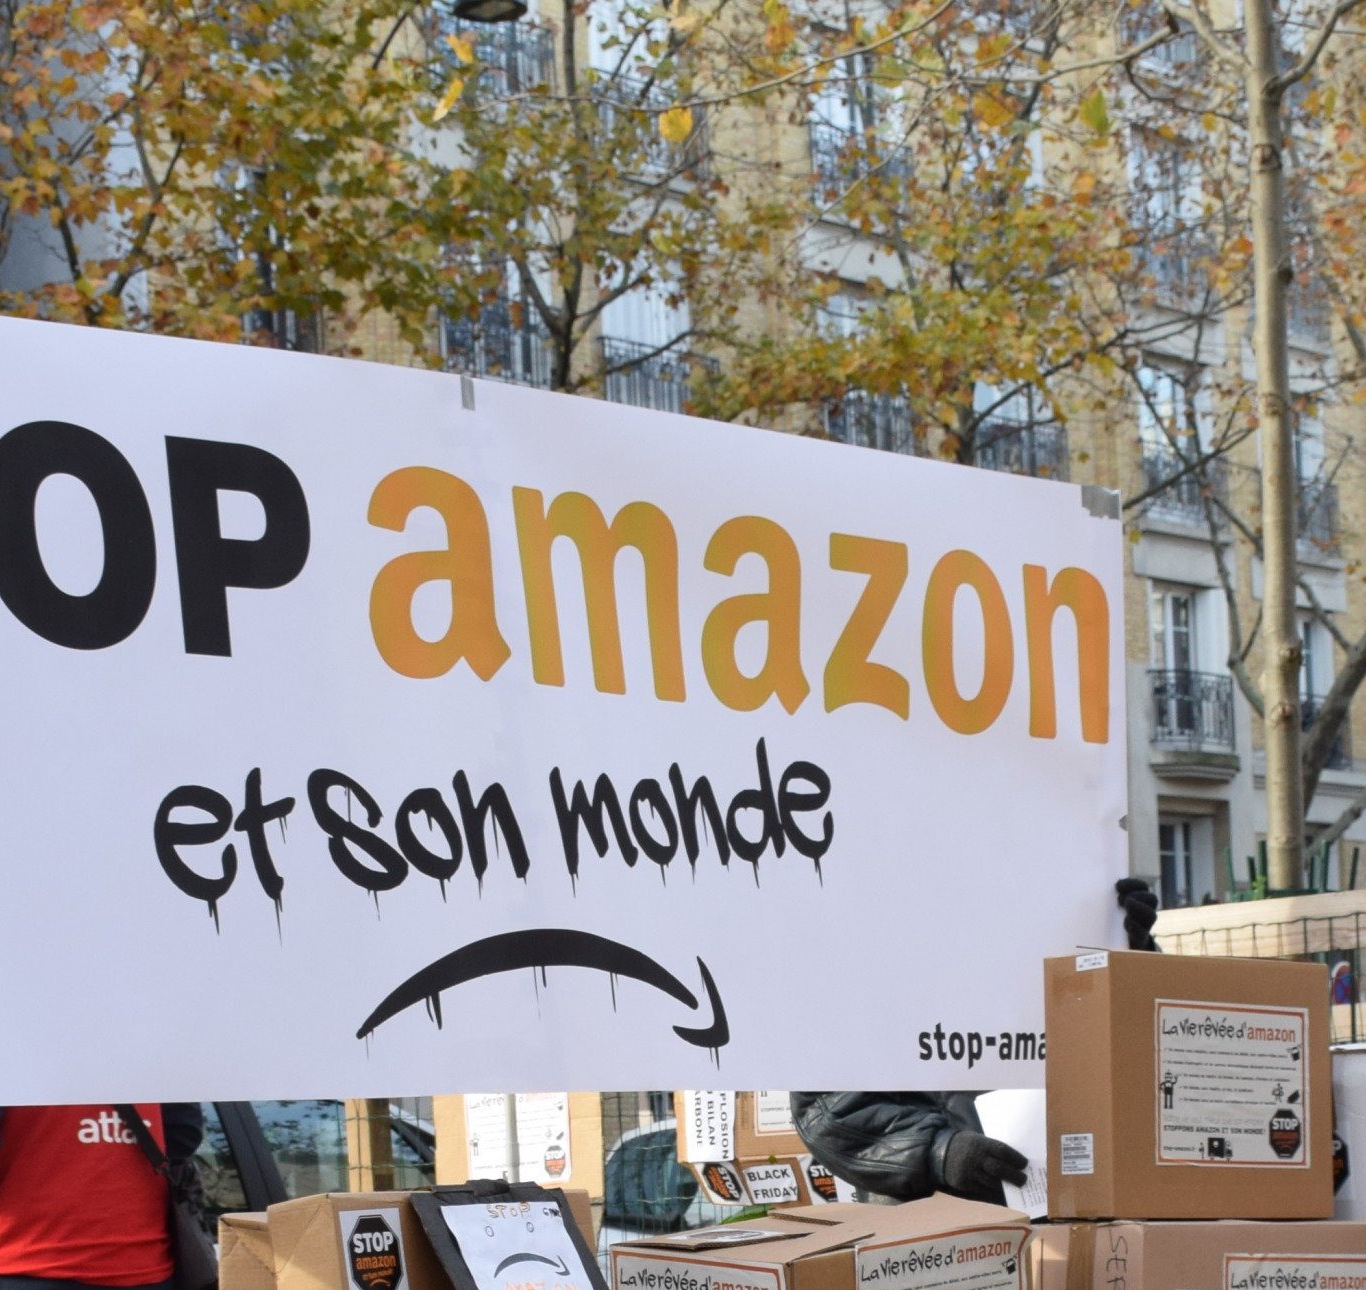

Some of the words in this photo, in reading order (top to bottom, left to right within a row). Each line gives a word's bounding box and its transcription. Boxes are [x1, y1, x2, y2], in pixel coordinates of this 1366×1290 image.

[368, 465, 1110, 744] amazon
[153, 767, 295, 925] et
[552, 739, 834, 896] monde
[78, 1111, 151, 1144] atta
[719, 1092, 729, 1159] PLOSION
[1272, 1118, 1298, 1130] STOP
[747, 1168, 790, 1182] BLACK
[810, 1167, 834, 1177] STO
[754, 1186, 797, 1200] FRIDAY
[486, 1201, 531, 1218] STOP
[353, 1231, 394, 1254] STOP
[356, 1256, 396, 1270] amazon
